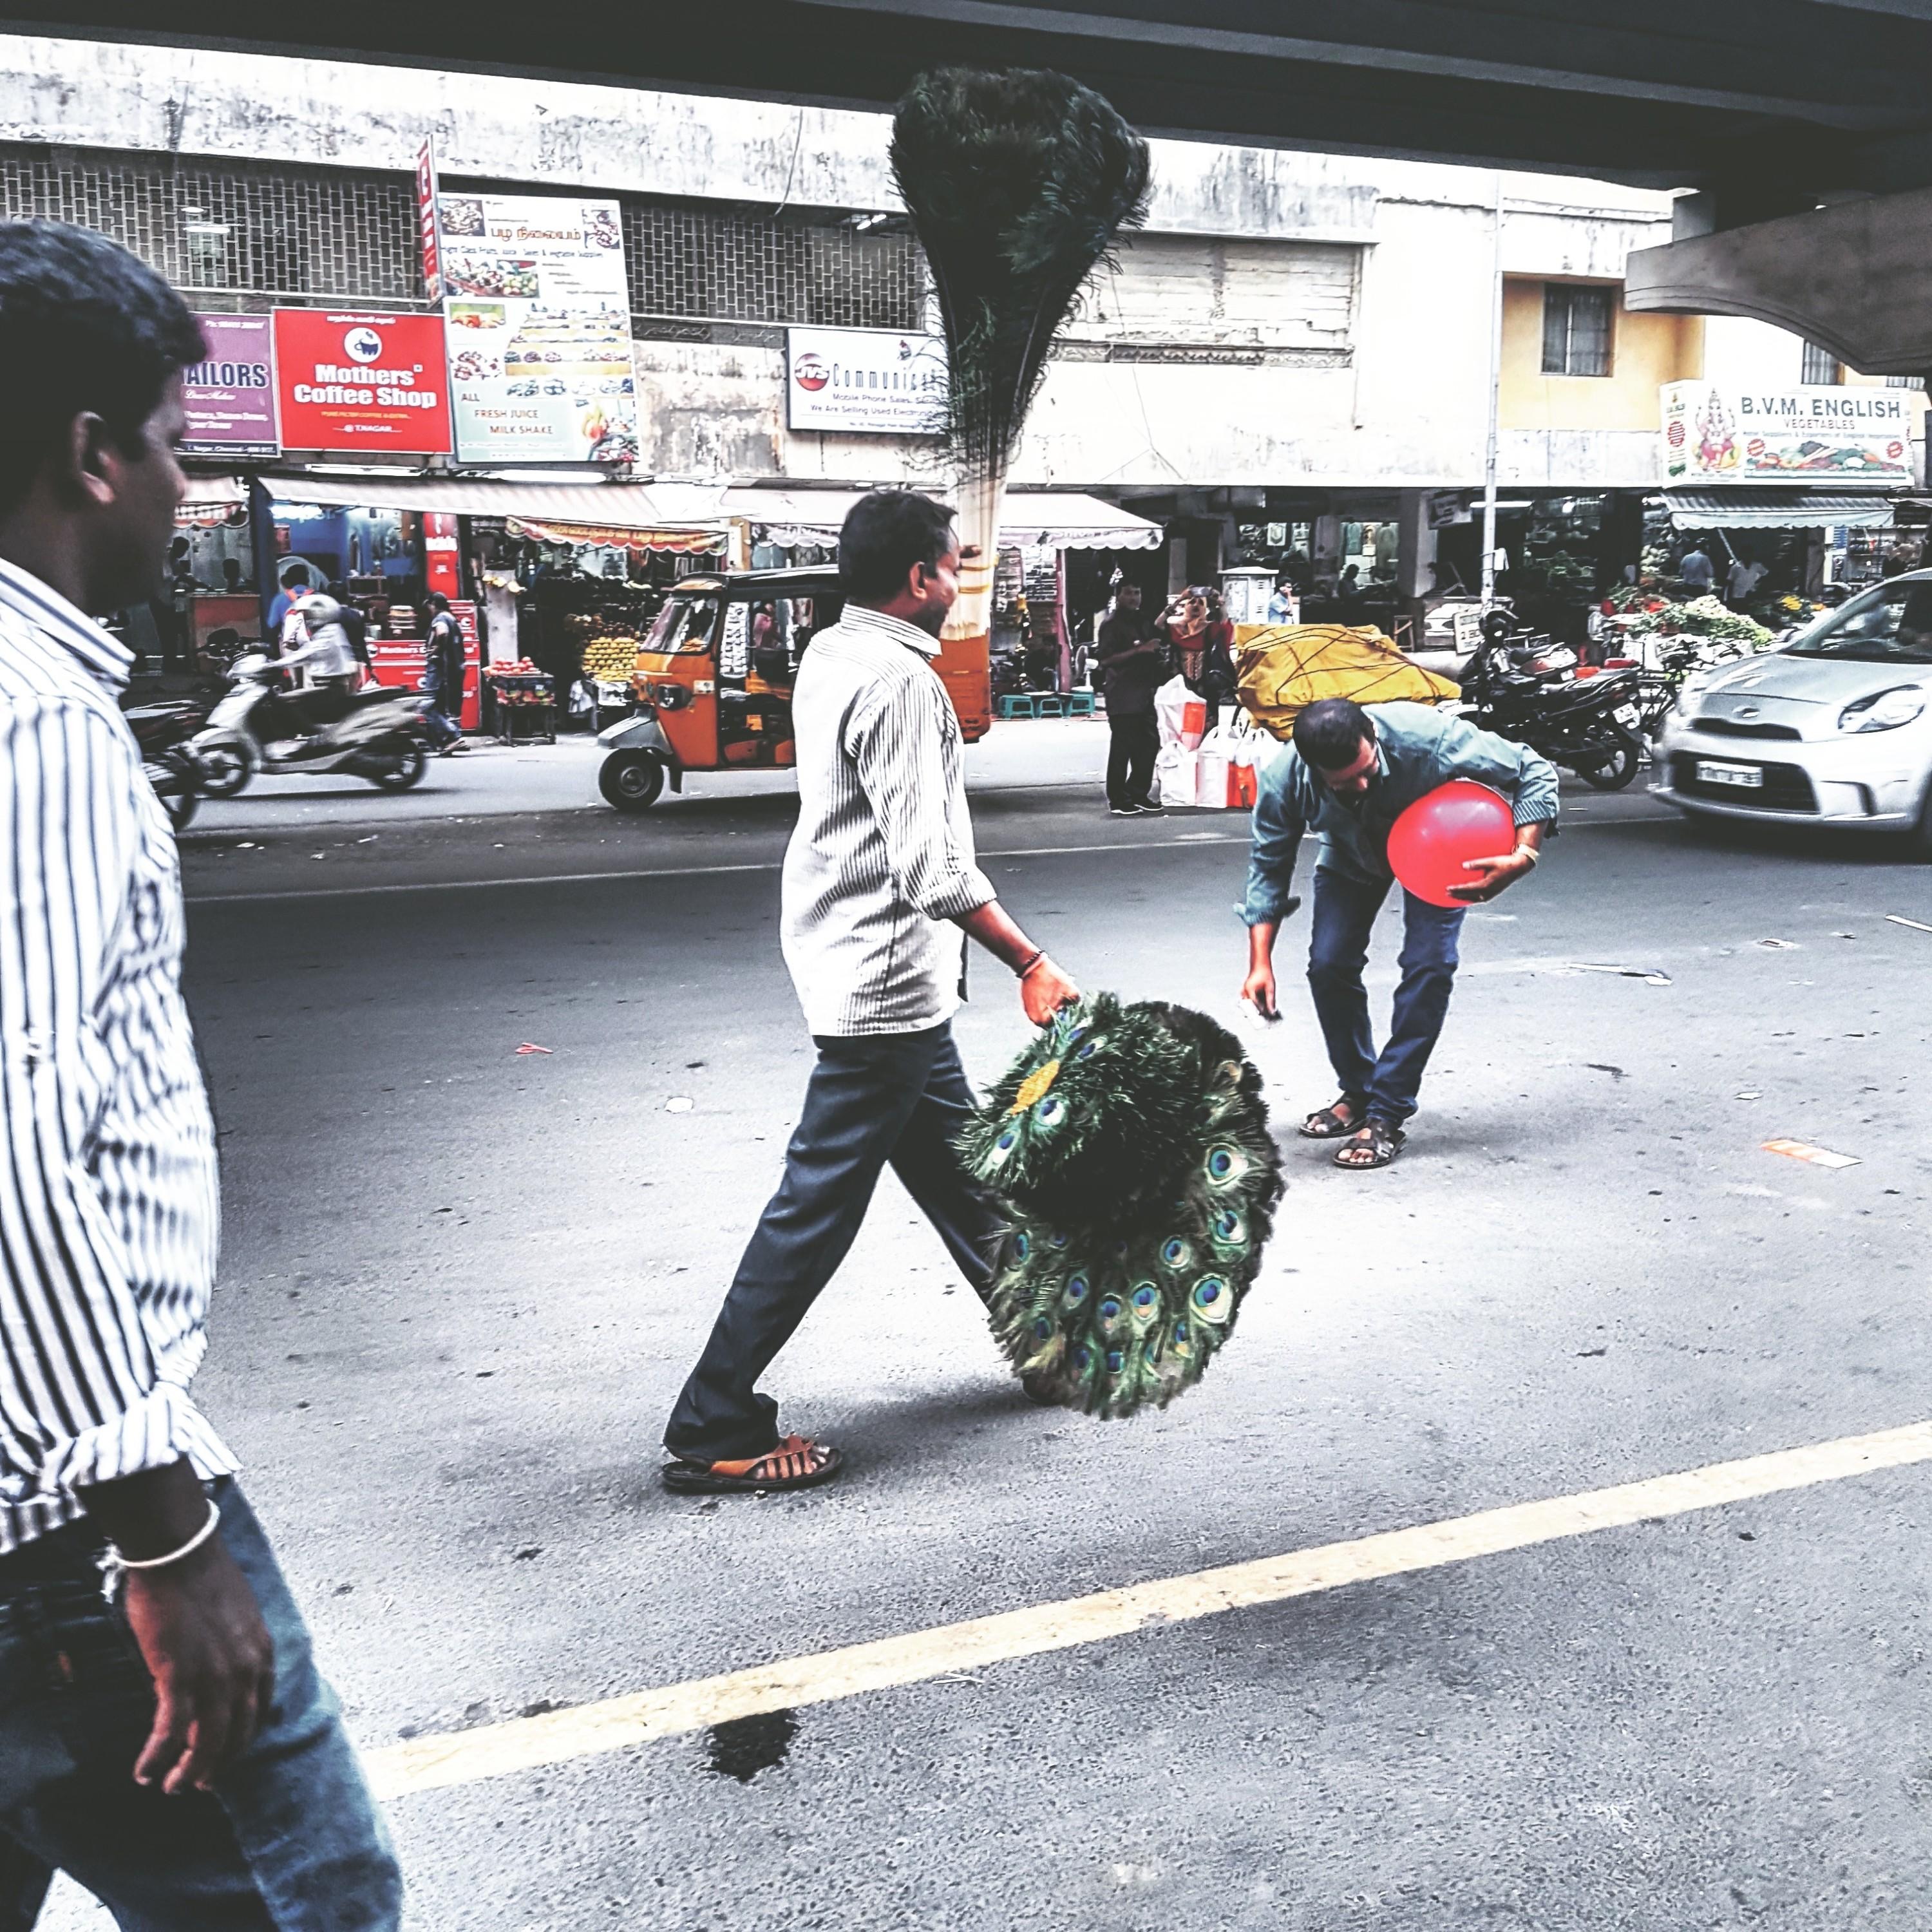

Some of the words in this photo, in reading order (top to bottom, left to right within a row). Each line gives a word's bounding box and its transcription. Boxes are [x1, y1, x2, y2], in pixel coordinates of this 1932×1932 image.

[184, 363, 269, 388] AILORS
[315, 364, 415, 386] Mothers
[294, 384, 374, 405] Coffee
[377, 386, 437, 409] Shop
[460, 393, 480, 402] ALL
[475, 409, 507, 419] FRESH
[511, 410, 539, 419] JUICE
[1741, 397, 1803, 415] B.V.M.
[1812, 399, 1900, 418] ENGLISH
[489, 425, 515, 434] MILK
[519, 426, 553, 435] SHAKE
[1784, 419, 1855, 430] VEGETABLES
